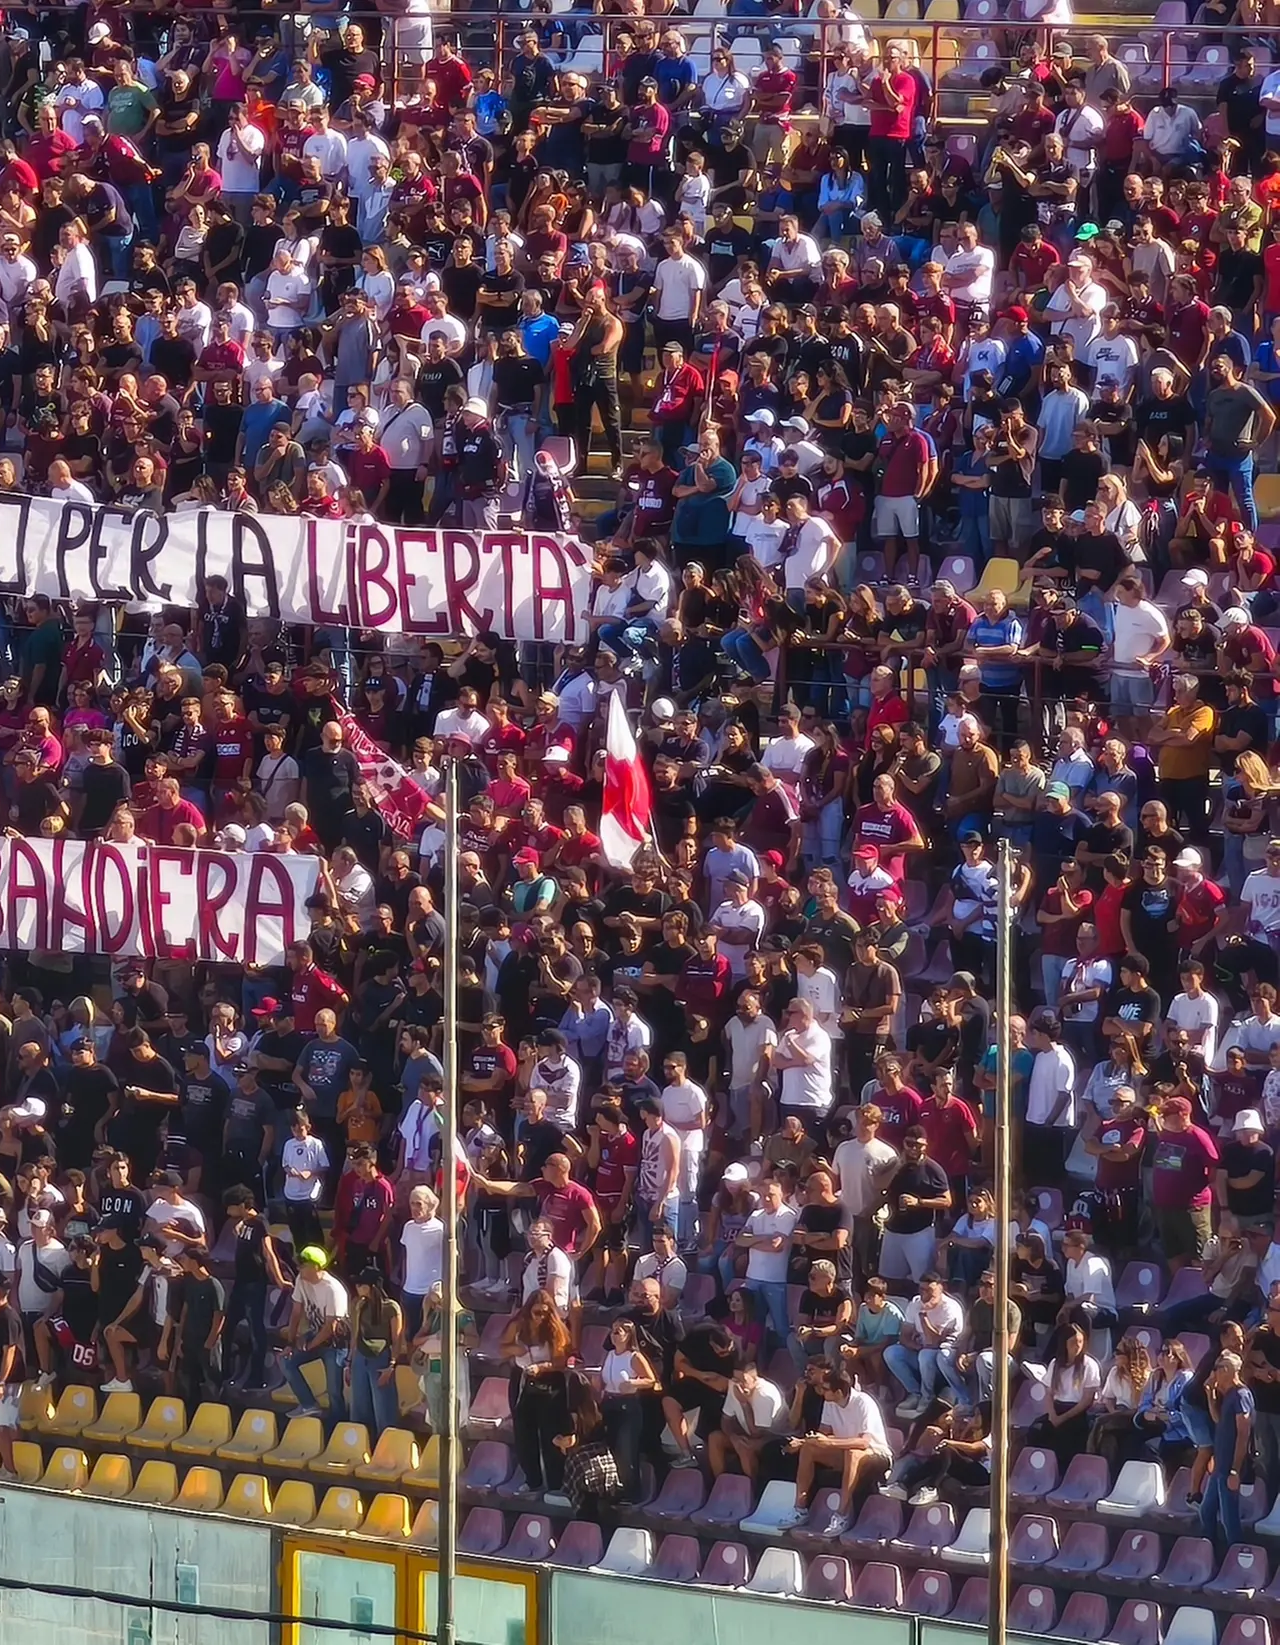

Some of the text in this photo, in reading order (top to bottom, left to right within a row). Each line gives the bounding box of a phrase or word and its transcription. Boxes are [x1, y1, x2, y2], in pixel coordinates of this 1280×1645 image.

[56, 502, 173, 601] PER
[197, 510, 282, 619] LA
[101, 1197, 134, 1214] ICON
